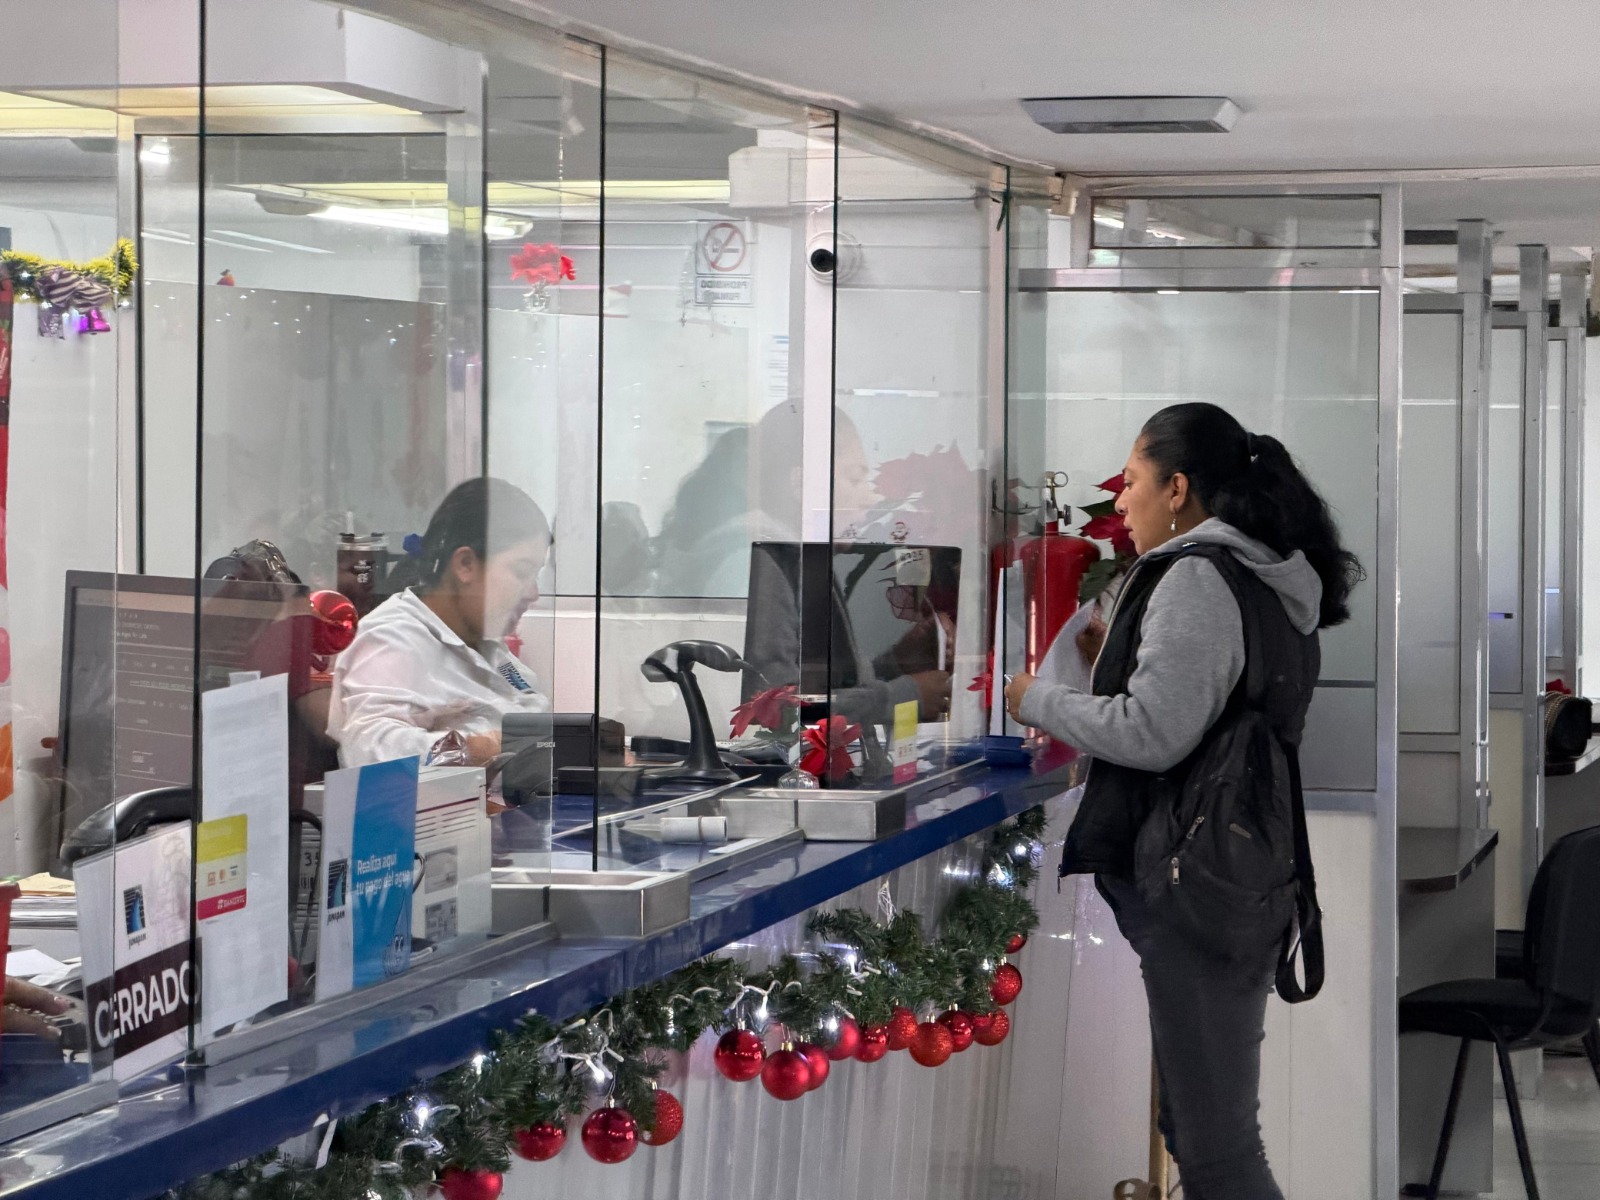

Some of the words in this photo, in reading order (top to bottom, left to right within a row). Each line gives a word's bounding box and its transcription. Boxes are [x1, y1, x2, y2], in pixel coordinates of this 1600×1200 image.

[356, 881, 364, 896] tu
[383, 870, 394, 888] del
[94, 960, 201, 1048] CERRADO
